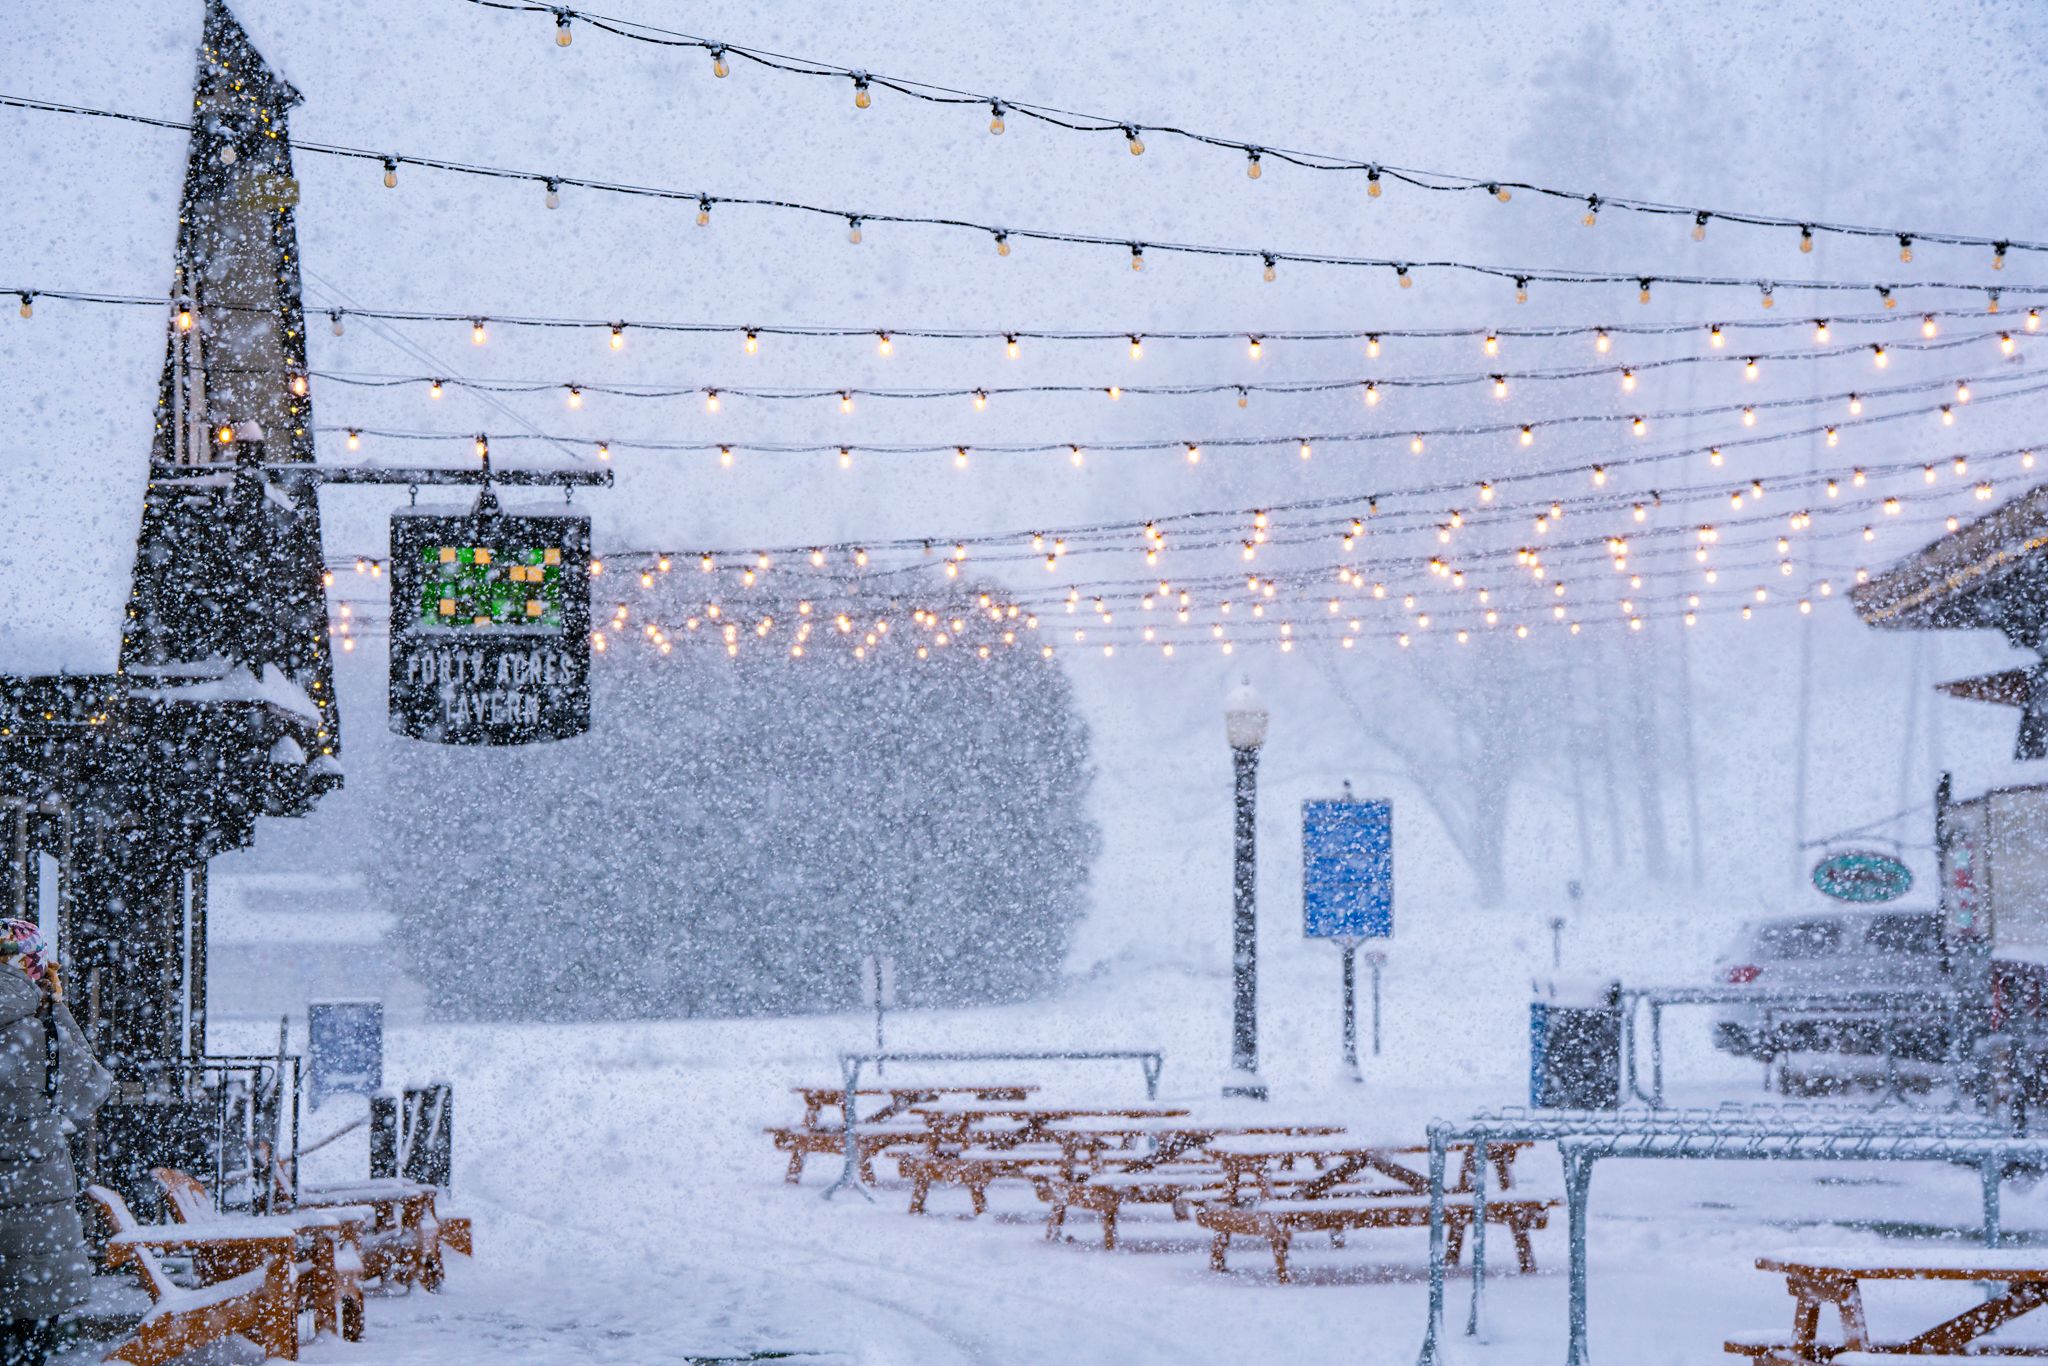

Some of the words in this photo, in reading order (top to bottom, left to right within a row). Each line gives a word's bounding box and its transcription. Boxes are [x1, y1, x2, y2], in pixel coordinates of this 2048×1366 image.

[408, 650, 484, 685] FORTY
[498, 649, 573, 685] ACRES
[441, 689, 540, 725] TAVERN
